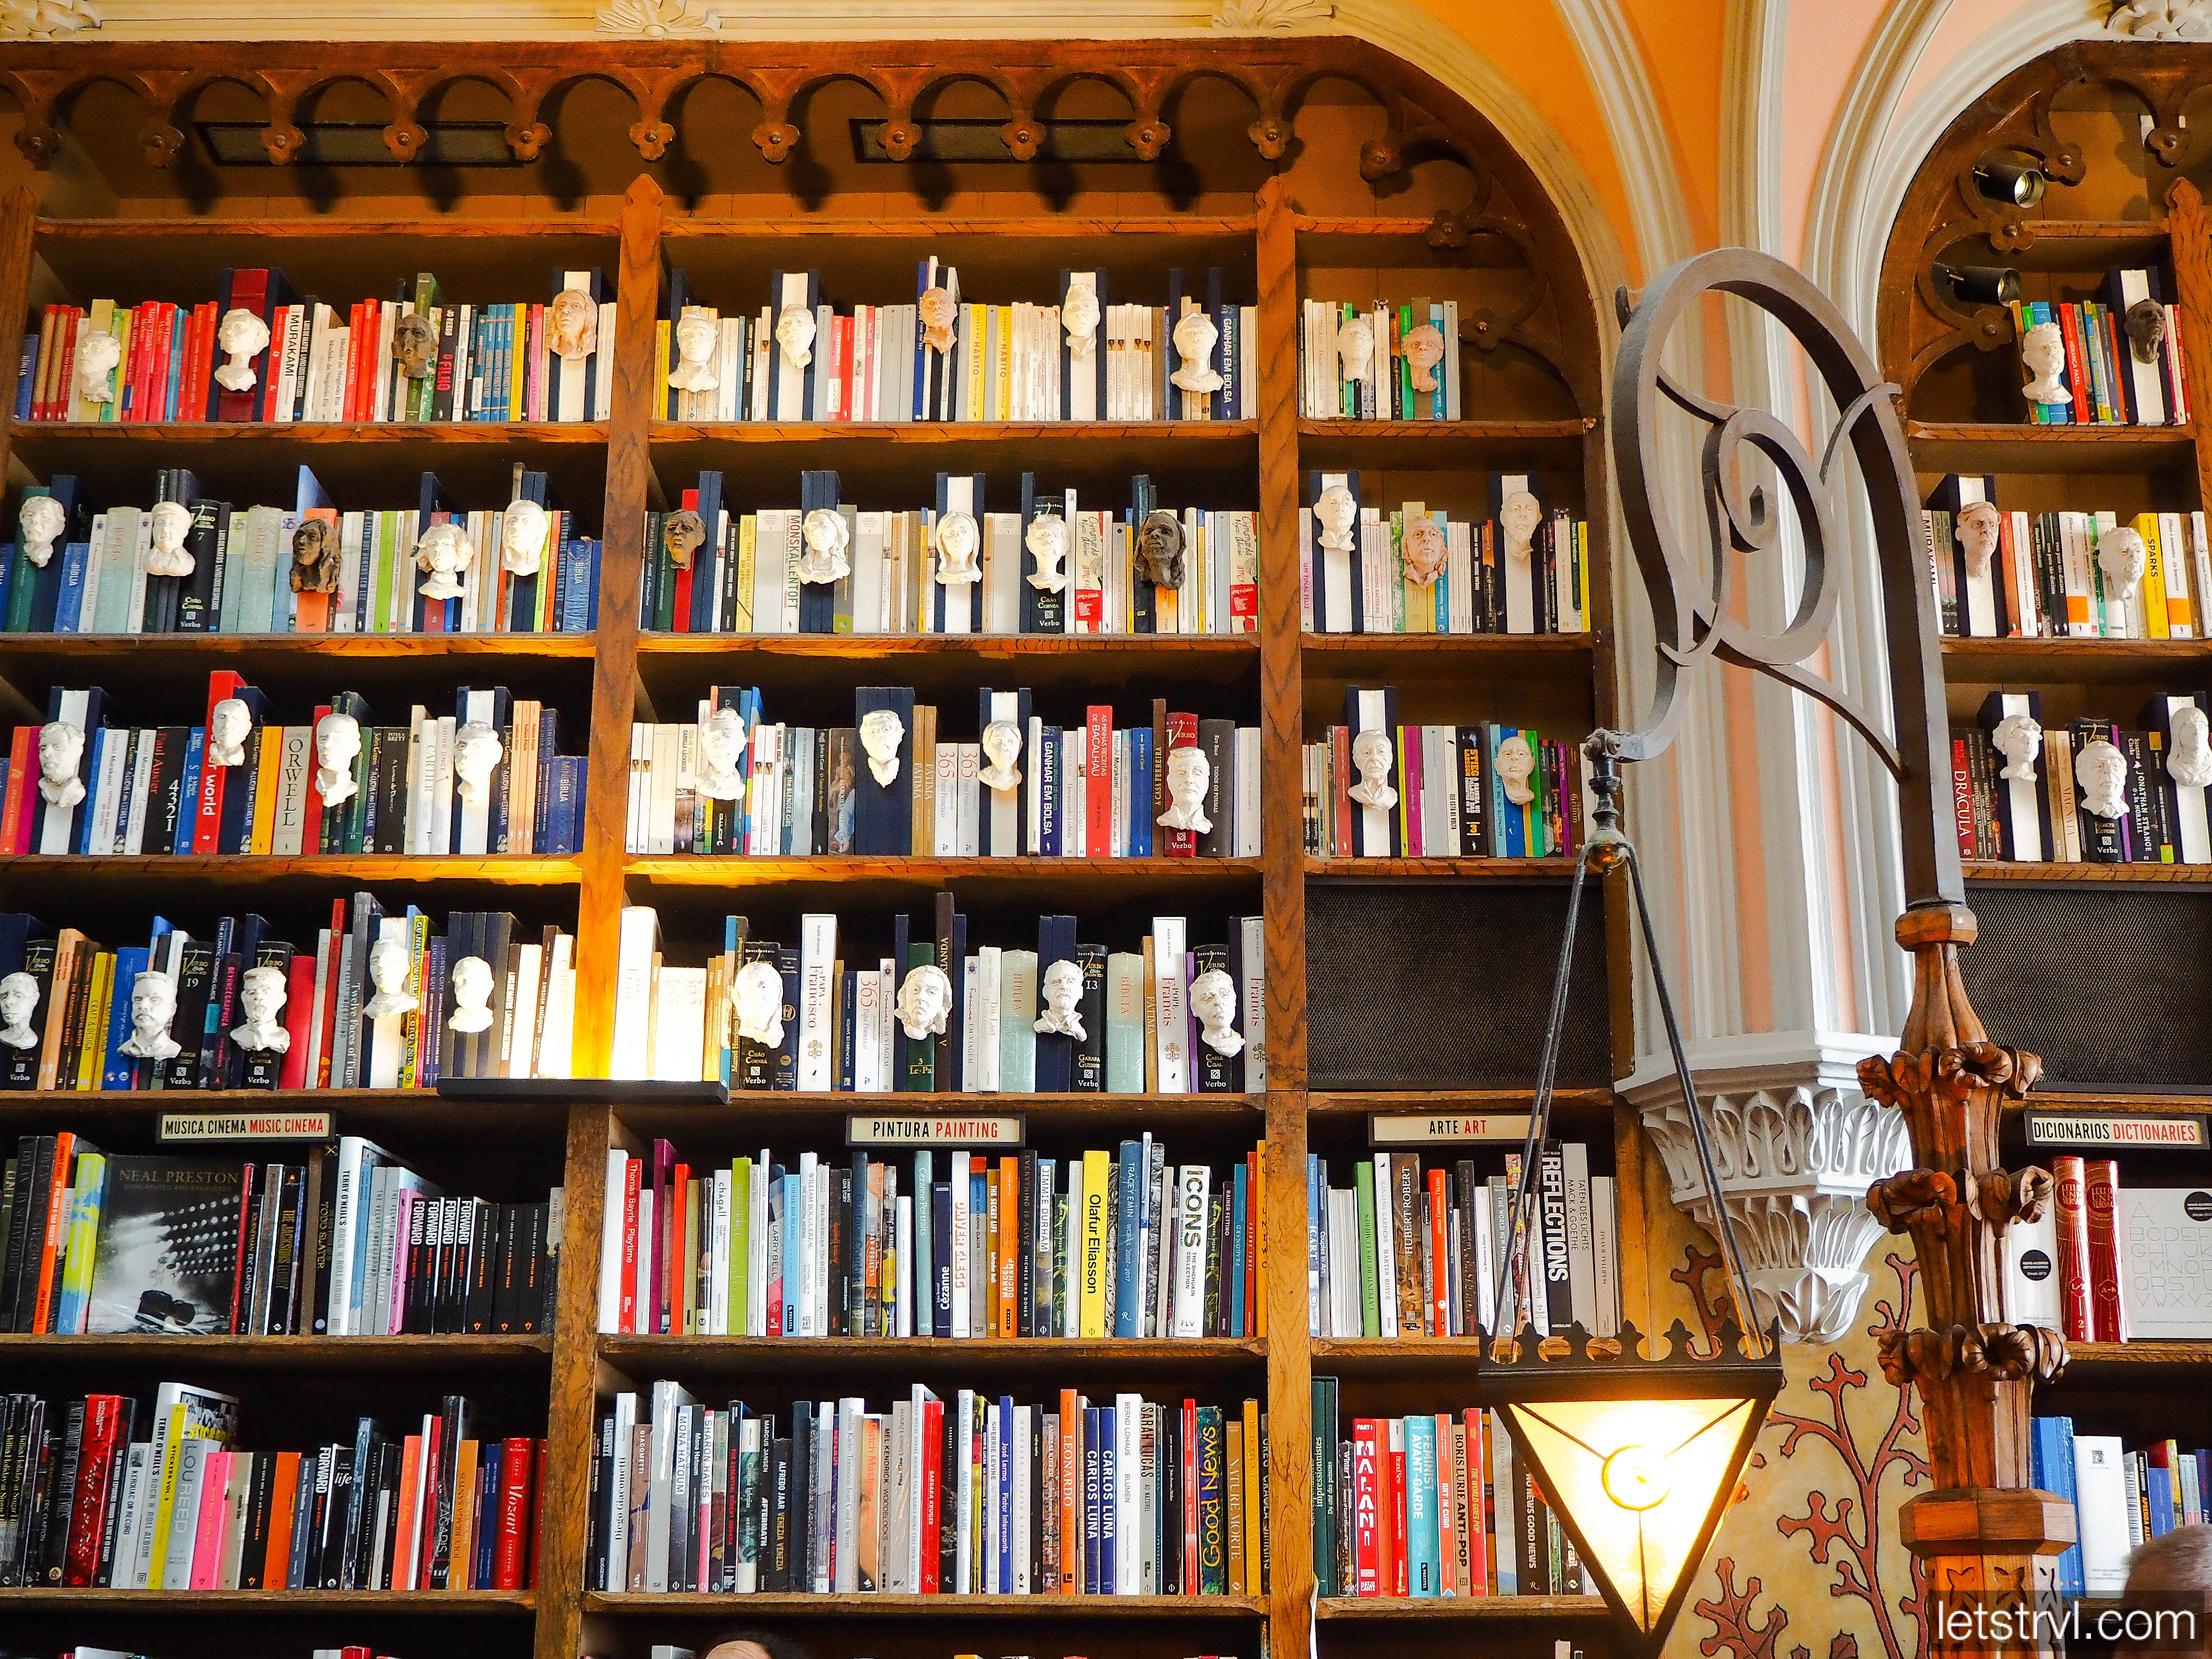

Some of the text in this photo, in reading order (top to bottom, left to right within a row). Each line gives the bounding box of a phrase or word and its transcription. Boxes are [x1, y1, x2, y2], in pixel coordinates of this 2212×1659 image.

[999, 344, 1008, 377] HÁBITO
[1223, 319, 1232, 403] GANHAR EM BOLSA
[1089, 517, 1100, 556] Chimamanda
[1303, 563, 1309, 572] UM
[2148, 539, 2158, 577] SPARKS
[938, 750, 954, 779] 365
[1091, 714, 1100, 777] DE BACALHAU
[1469, 749, 1479, 776] STIEG
[203, 774, 217, 816] world
[925, 764, 934, 800] FÁTIMA
[1043, 742, 1053, 834] GANHAR EM BOLSA
[1955, 771, 1971, 836] DRÁCULA
[2137, 772, 2152, 851] JONATHAN STRANGE
[187, 978, 199, 987] 19
[807, 965, 823, 1028] Francisco
[860, 979, 878, 1008] 365
[1086, 981, 1098, 989] 13
[1161, 977, 1176, 1027] Francis
[346, 983, 360, 1085] Twelve Faces of Time
[165, 1118, 323, 1134] MÚSICA CINEMA MUSIC CINEMA
[873, 1121, 998, 1138] PINTURA PAINTING
[1429, 1120, 1486, 1134] ARTE ART
[2033, 1120, 2195, 1141] DICIONÁRIOS DICTIONARIES
[120, 1170, 238, 1183] NEAL PRESTON
[918, 1167, 927, 1200] Cézanne
[1578, 1179, 1587, 1202] TATEN
[626, 1165, 638, 1263] Thomas Bayrle Playtime
[716, 1182, 727, 1216] chagall
[1126, 1197, 1135, 1217] EMIN
[1184, 1170, 1203, 1247] ICONS
[1401, 1167, 1413, 1254] HUBERT ROBERT
[1542, 1158, 1568, 1281] REFLECTIONS
[459, 1201, 471, 1244] FORWARD
[1040, 1208, 1048, 1250] DURHAM
[1570, 1215, 1578, 1251] GOETHE
[1580, 1224, 1589, 1250] LICHTS
[771, 1225, 779, 1276] LARRY BELL
[955, 1201, 967, 1287] OLIVER CLEGG
[1086, 1195, 1101, 1294] Olafur Eliasson
[940, 1266, 951, 1310] Cézanne
[676, 1416, 686, 1493] MONA HATOUM
[1141, 1407, 1154, 1477] SARAH LUCAS
[1424, 1435, 1433, 1491] FEMINIST
[316, 1448, 331, 1493] FORWARD
[702, 1466, 711, 1498] HAYES
[778, 1461, 786, 1490] ALFREDO
[1063, 1436, 1073, 1506] LEONARDO
[1413, 1434, 1422, 1518] AVANT-GARDE
[505, 1484, 522, 1534] Mozart
[615, 1457, 626, 1540] Diego Giacometti
[777, 1492, 785, 1509] JAAR
[1103, 1451, 1114, 1538] CARLOS LUNA
[1202, 1427, 1218, 1567] Good News
[1455, 1434, 1467, 1566] BORIS LURIE ANTI-POP
[777, 1513, 785, 1540] VENEZIA
[1527, 1515, 1535, 1541] GOOD
[1527, 1543, 1536, 1568] NEWS
